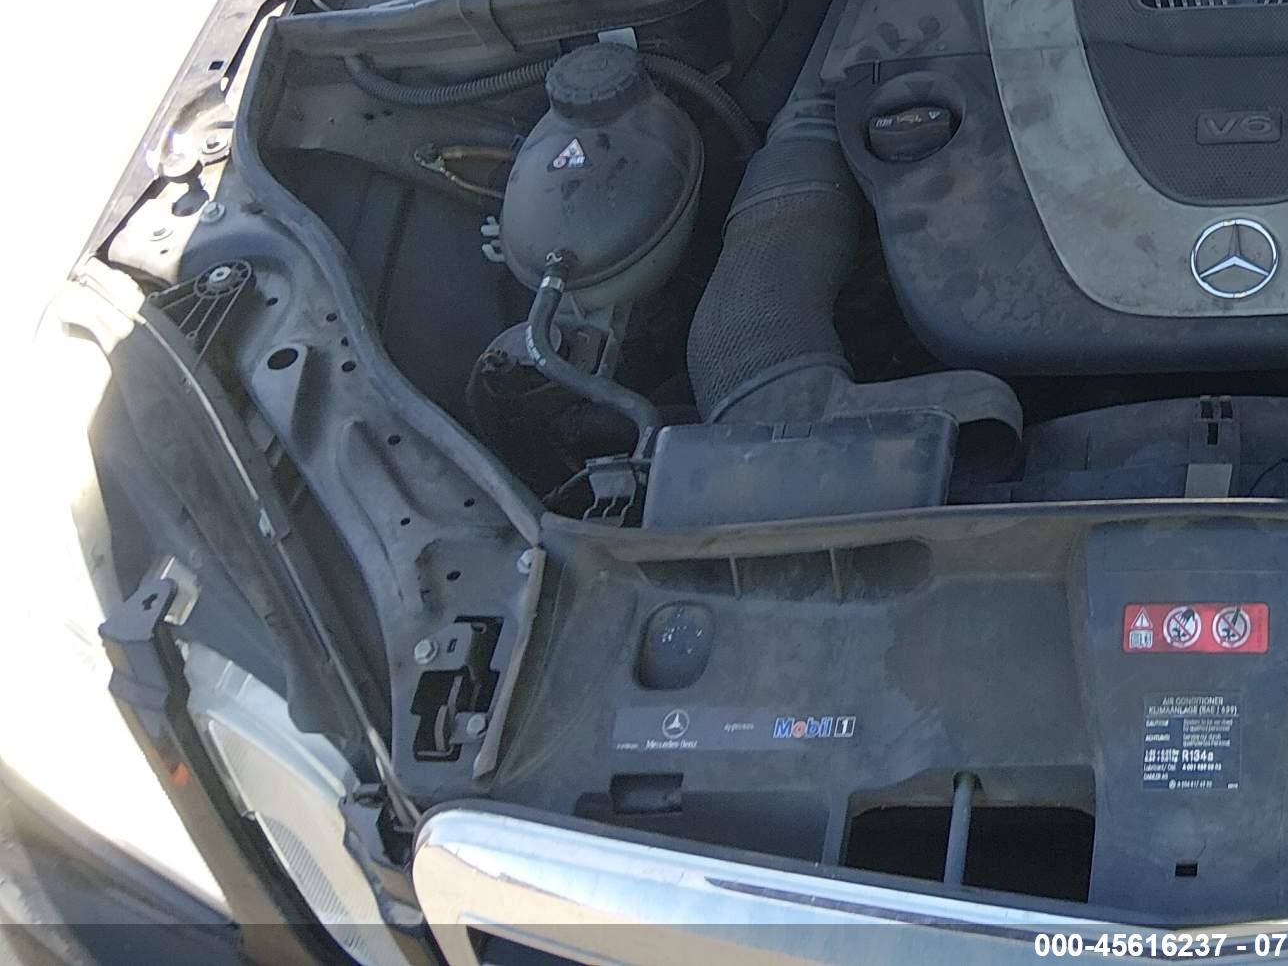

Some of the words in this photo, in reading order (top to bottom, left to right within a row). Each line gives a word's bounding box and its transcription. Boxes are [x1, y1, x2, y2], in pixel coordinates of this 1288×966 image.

[1203, 115, 1272, 137] V6
[1162, 696, 1174, 706] AIR
[1175, 696, 1224, 706] CONDITIONER
[772, 717, 833, 739] Mobil
[1182, 748, 1214, 762] R134a
